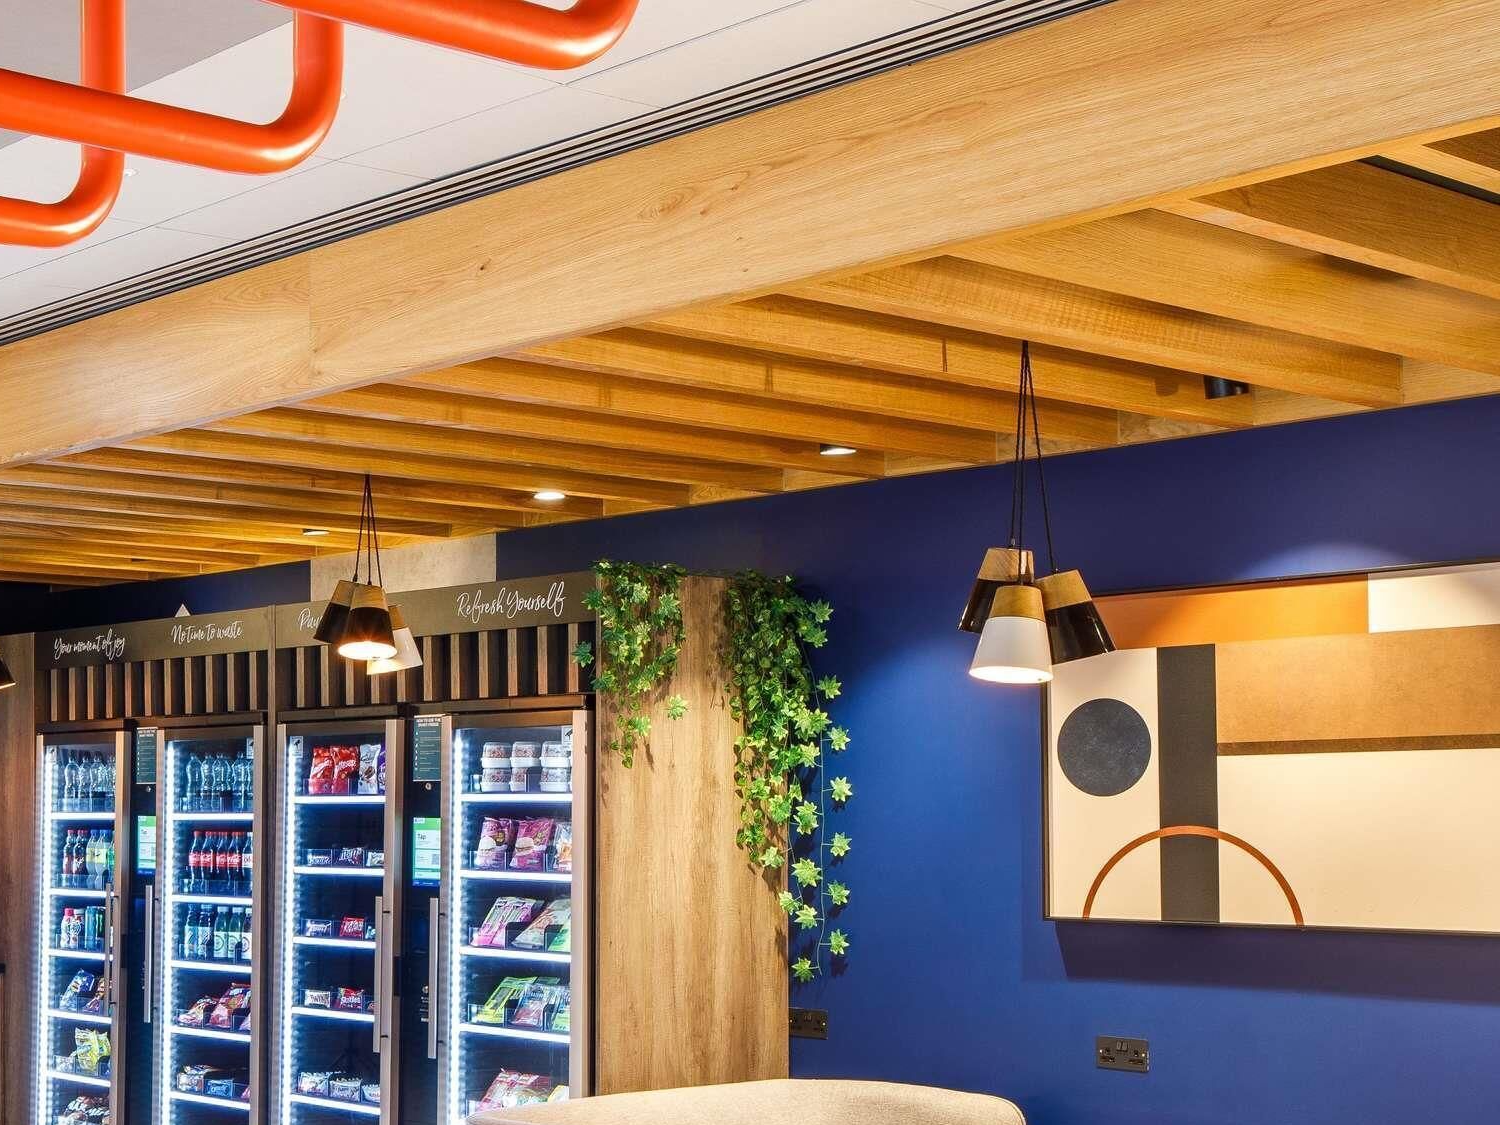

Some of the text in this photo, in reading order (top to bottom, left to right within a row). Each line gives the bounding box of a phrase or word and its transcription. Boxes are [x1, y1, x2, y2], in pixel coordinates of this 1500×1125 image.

[457, 581, 566, 624] Refresh Yourself
[171, 624, 186, 645] No
